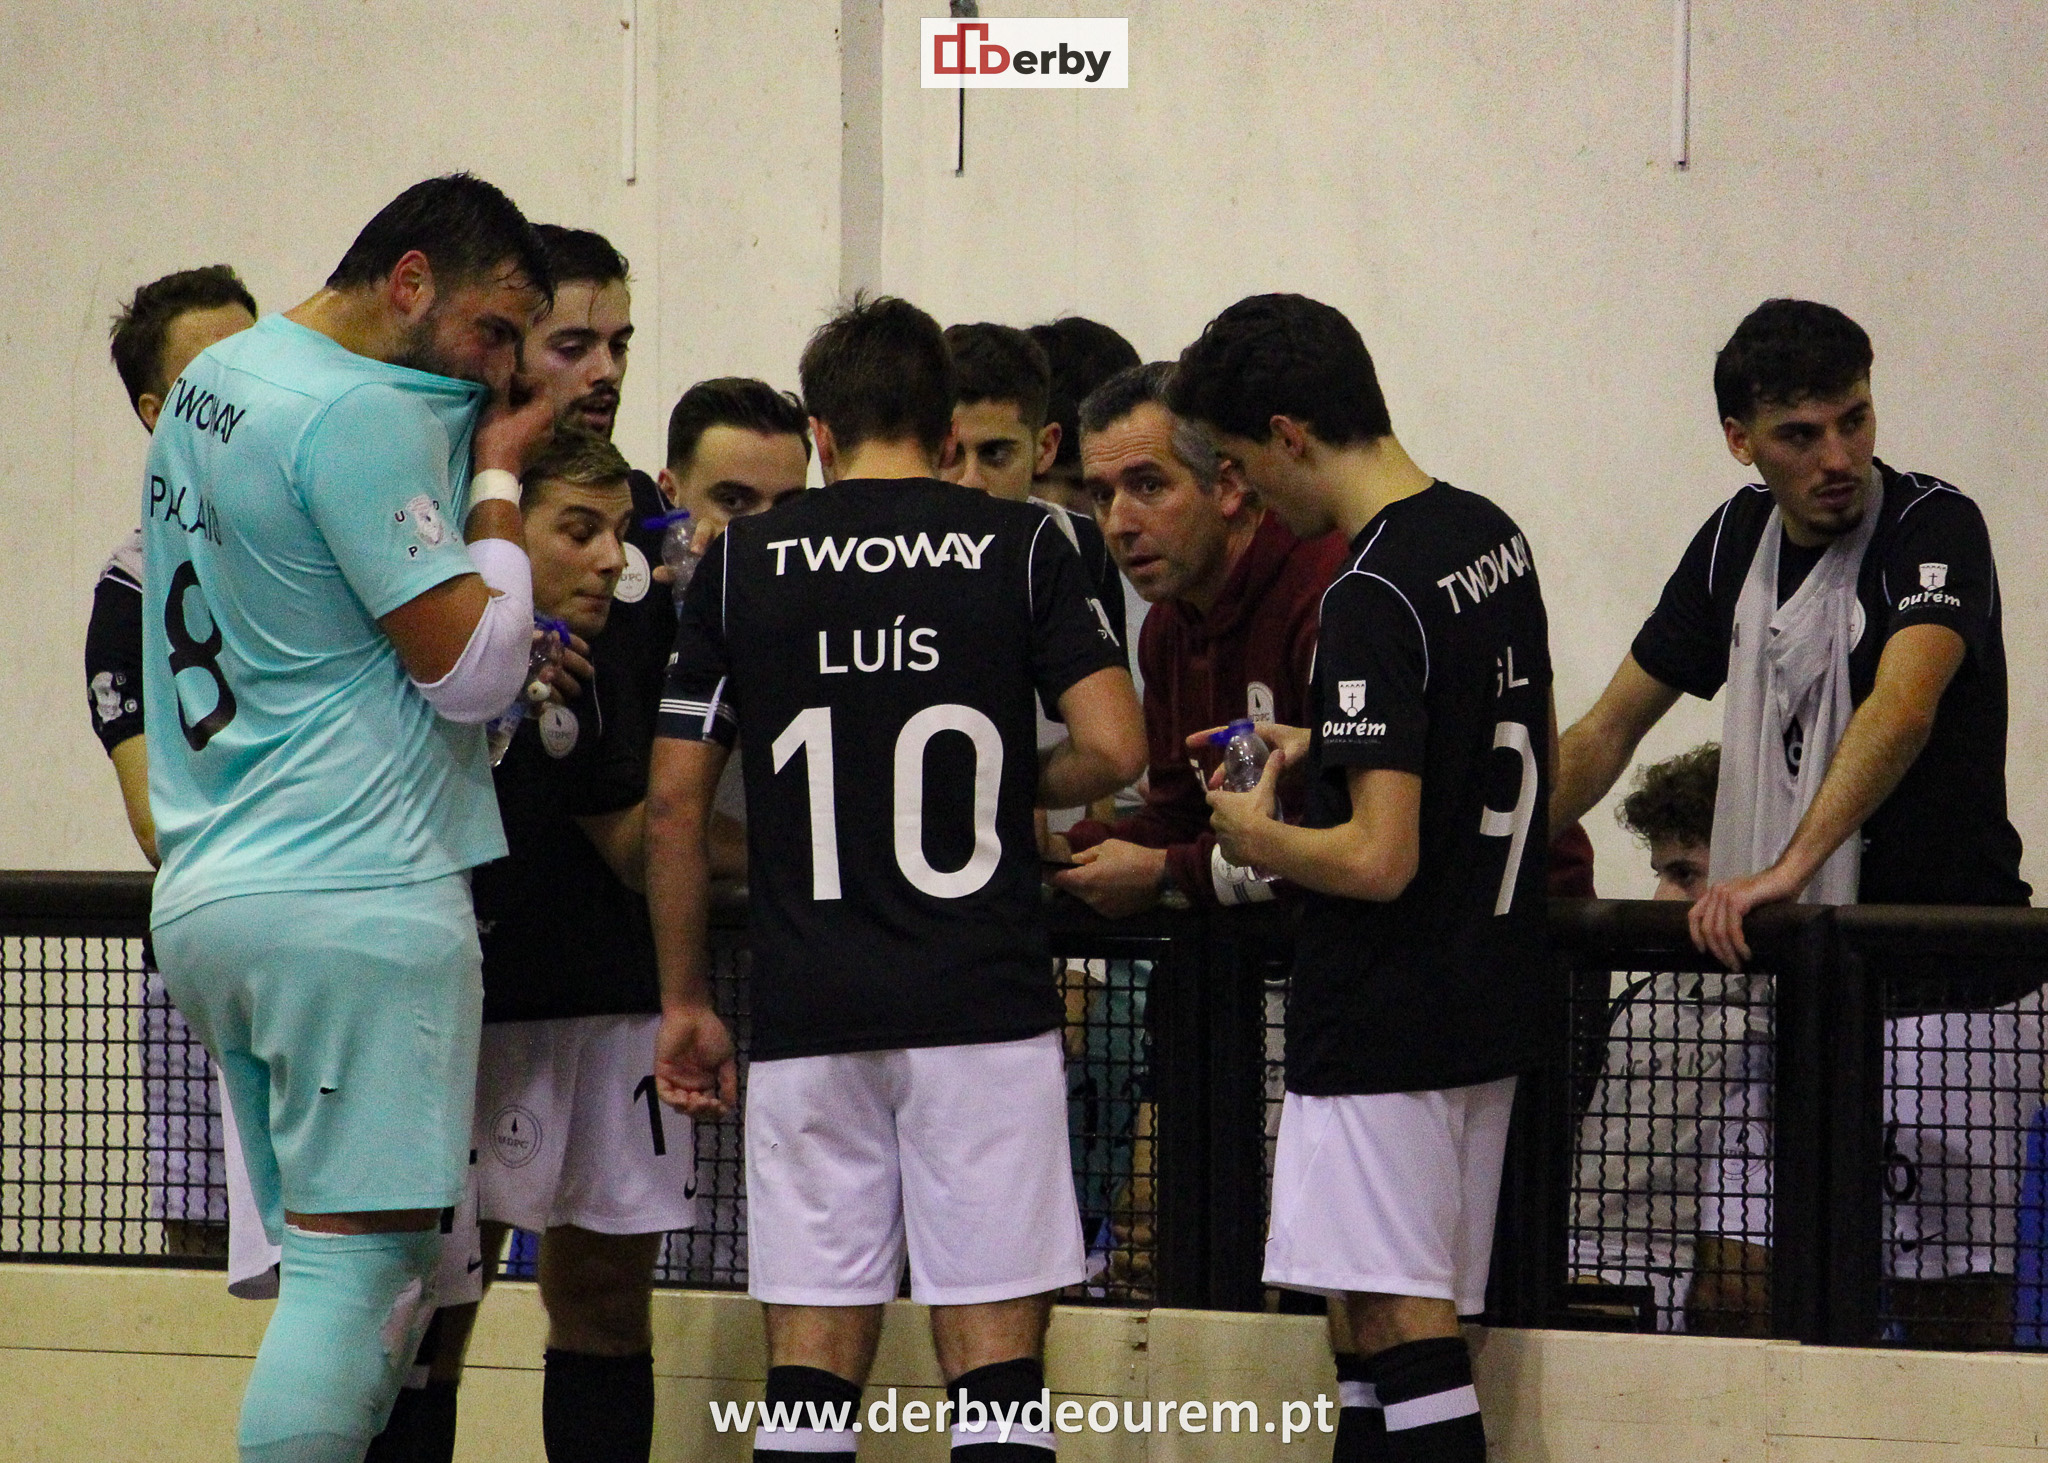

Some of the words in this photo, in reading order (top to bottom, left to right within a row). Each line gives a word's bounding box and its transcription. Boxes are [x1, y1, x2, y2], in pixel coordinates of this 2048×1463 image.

[766, 532, 996, 576] TWOWAY
[164, 560, 237, 752] 8
[818, 615, 940, 674] LUÍS
[1322, 717, 1387, 738] Ourém
[771, 703, 1004, 901] 10
[1479, 721, 1538, 916] 9
